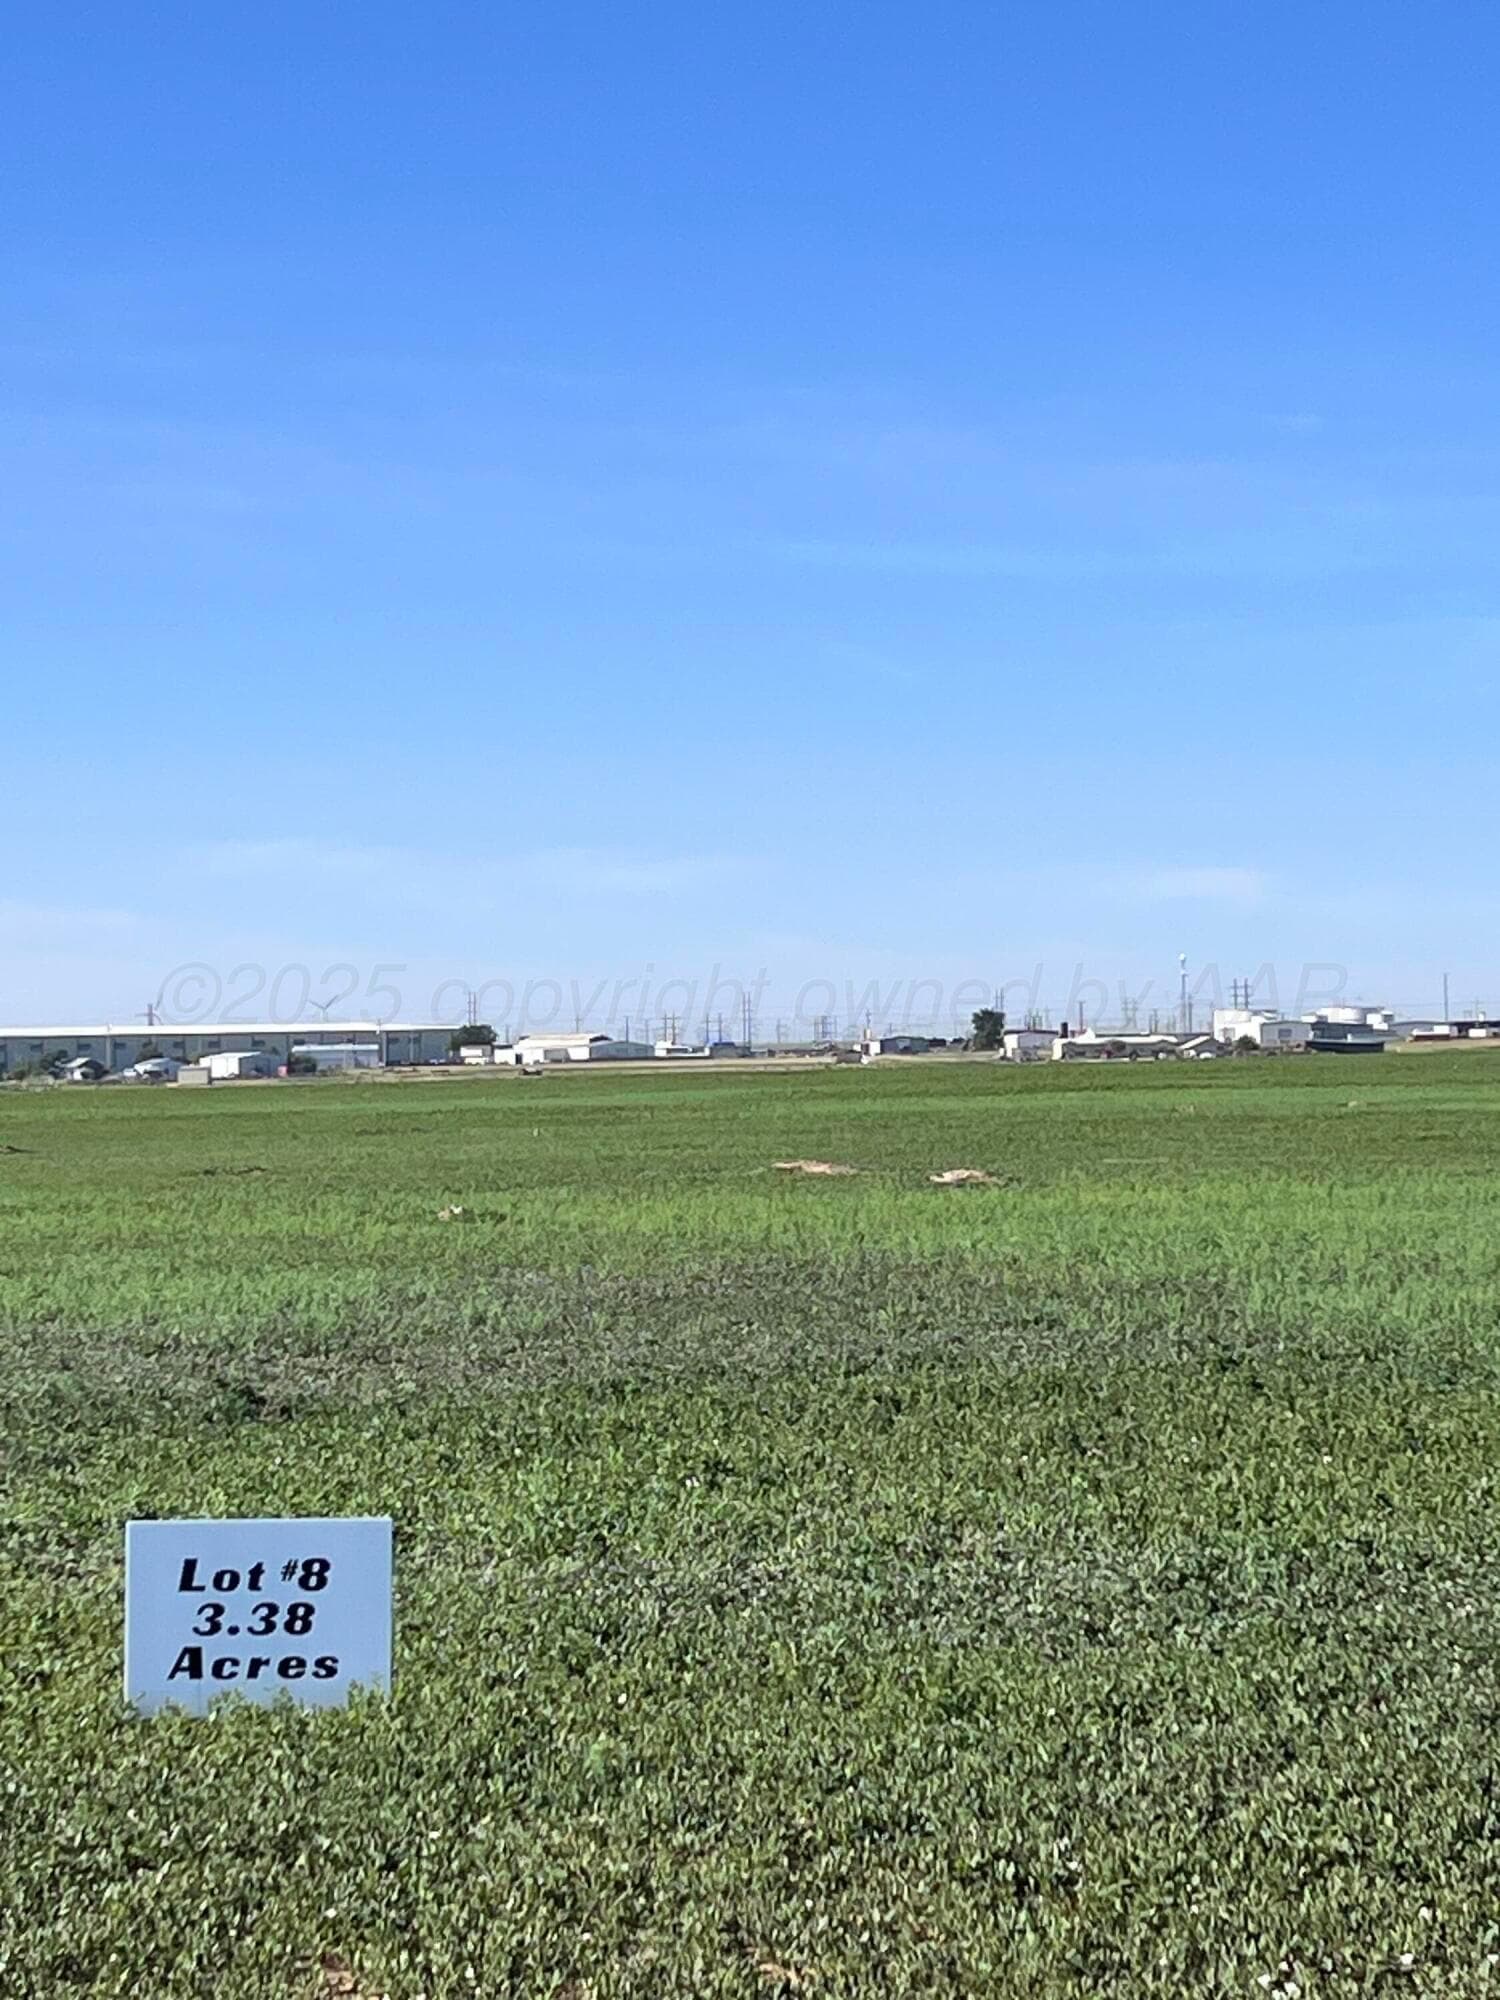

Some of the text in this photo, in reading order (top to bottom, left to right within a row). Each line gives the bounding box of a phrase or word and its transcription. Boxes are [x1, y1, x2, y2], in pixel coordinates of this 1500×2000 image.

[178, 1557, 331, 1593] Lot #8
[191, 1601, 316, 1637] 3.38
[166, 1645, 340, 1680] Acres
